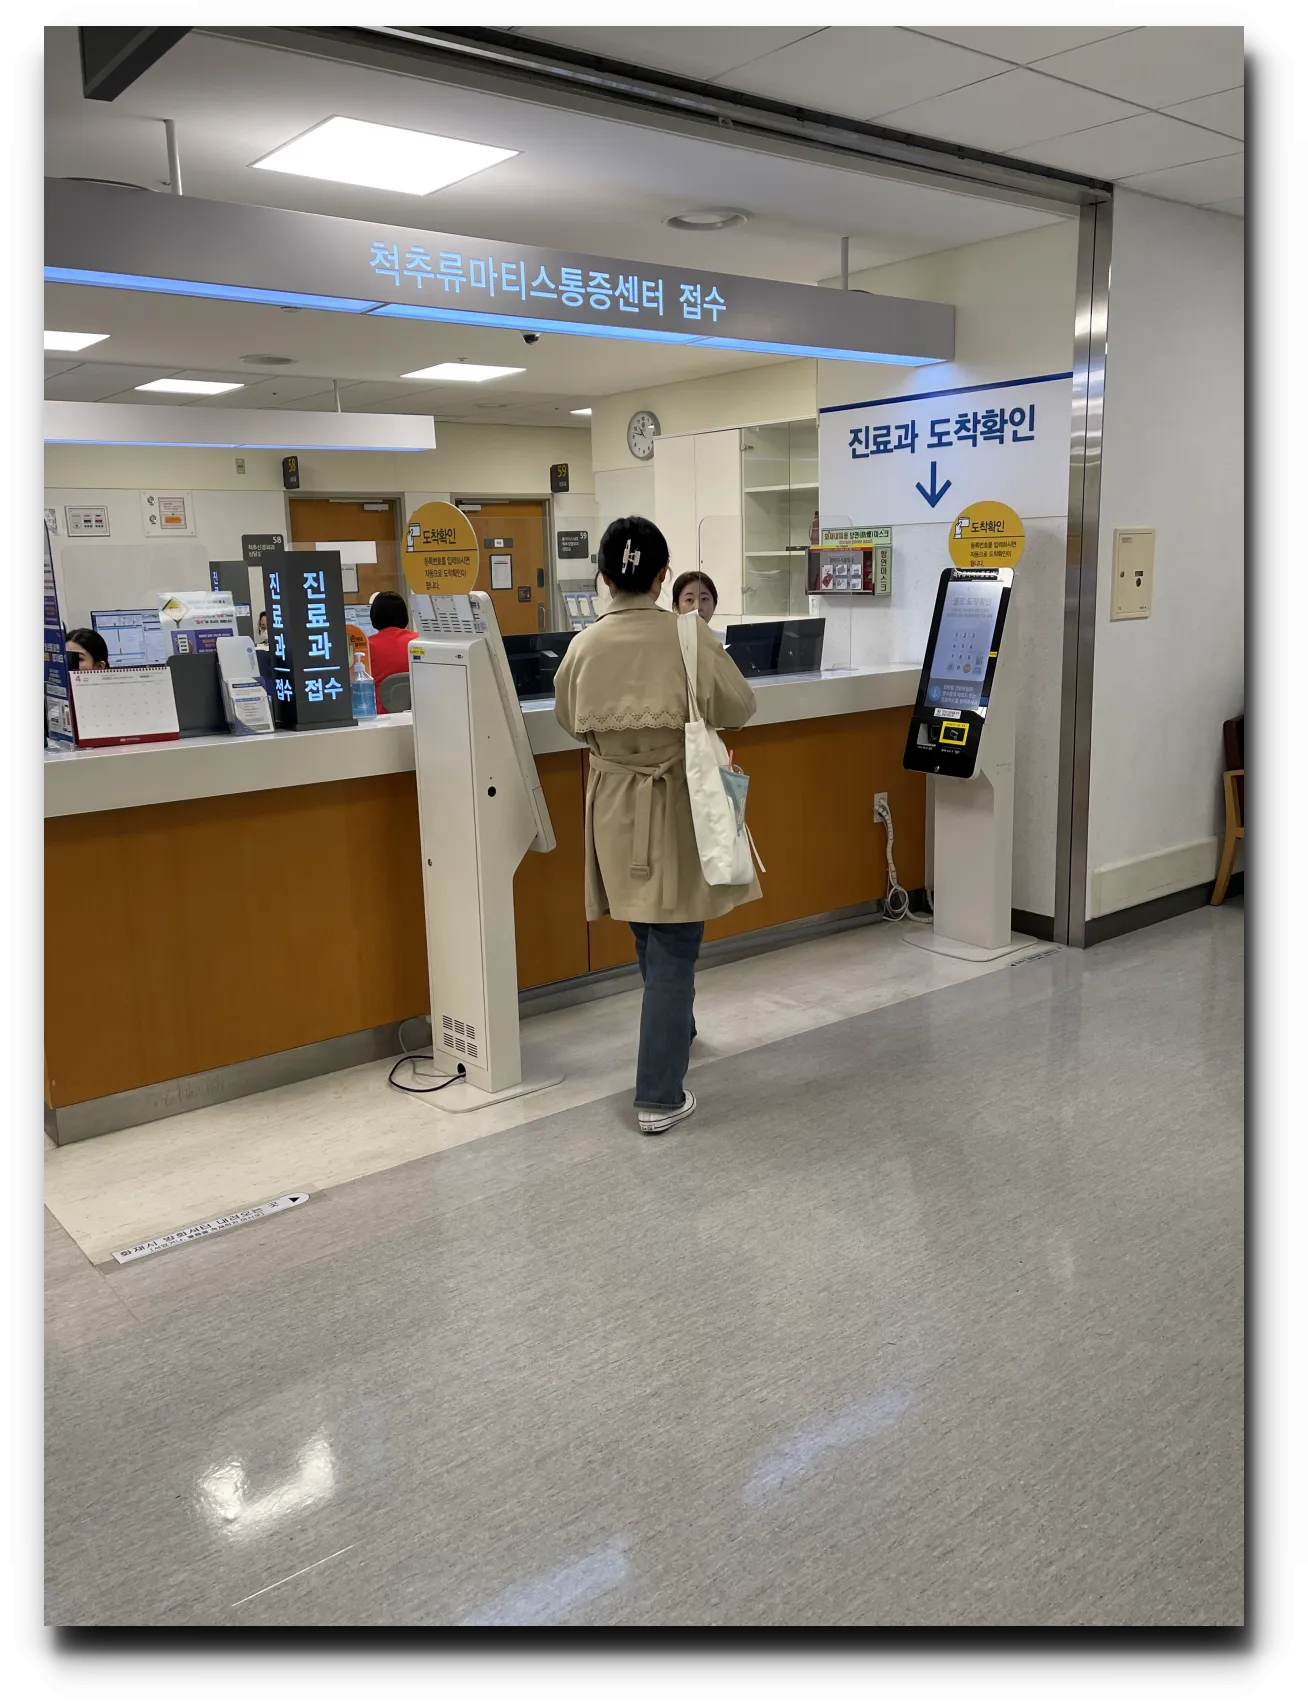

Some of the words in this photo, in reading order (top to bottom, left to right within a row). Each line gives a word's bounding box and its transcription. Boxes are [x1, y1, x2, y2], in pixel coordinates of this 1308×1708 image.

[369, 240, 665, 317] 척추류마티스통증센터
[679, 281, 727, 323] 접수
[847, 419, 919, 459] 진료과
[926, 404, 1035, 449] 도착확인
[557, 465, 567, 478] 59
[422, 528, 456, 545] 도착확인
[971, 520, 1005, 533] 도착확인
[272, 536, 282, 544] 58
[424, 570, 442, 579] 자동으로
[269, 571, 286, 661] 진료과
[302, 570, 332, 660] 진료과
[275, 678, 293, 702] 접수
[304, 677, 343, 702] 접수
[120, 1240, 158, 1257] 화재시
[216, 1208, 264, 1225] 내려오는
[268, 1201, 279, 1210] 곳
